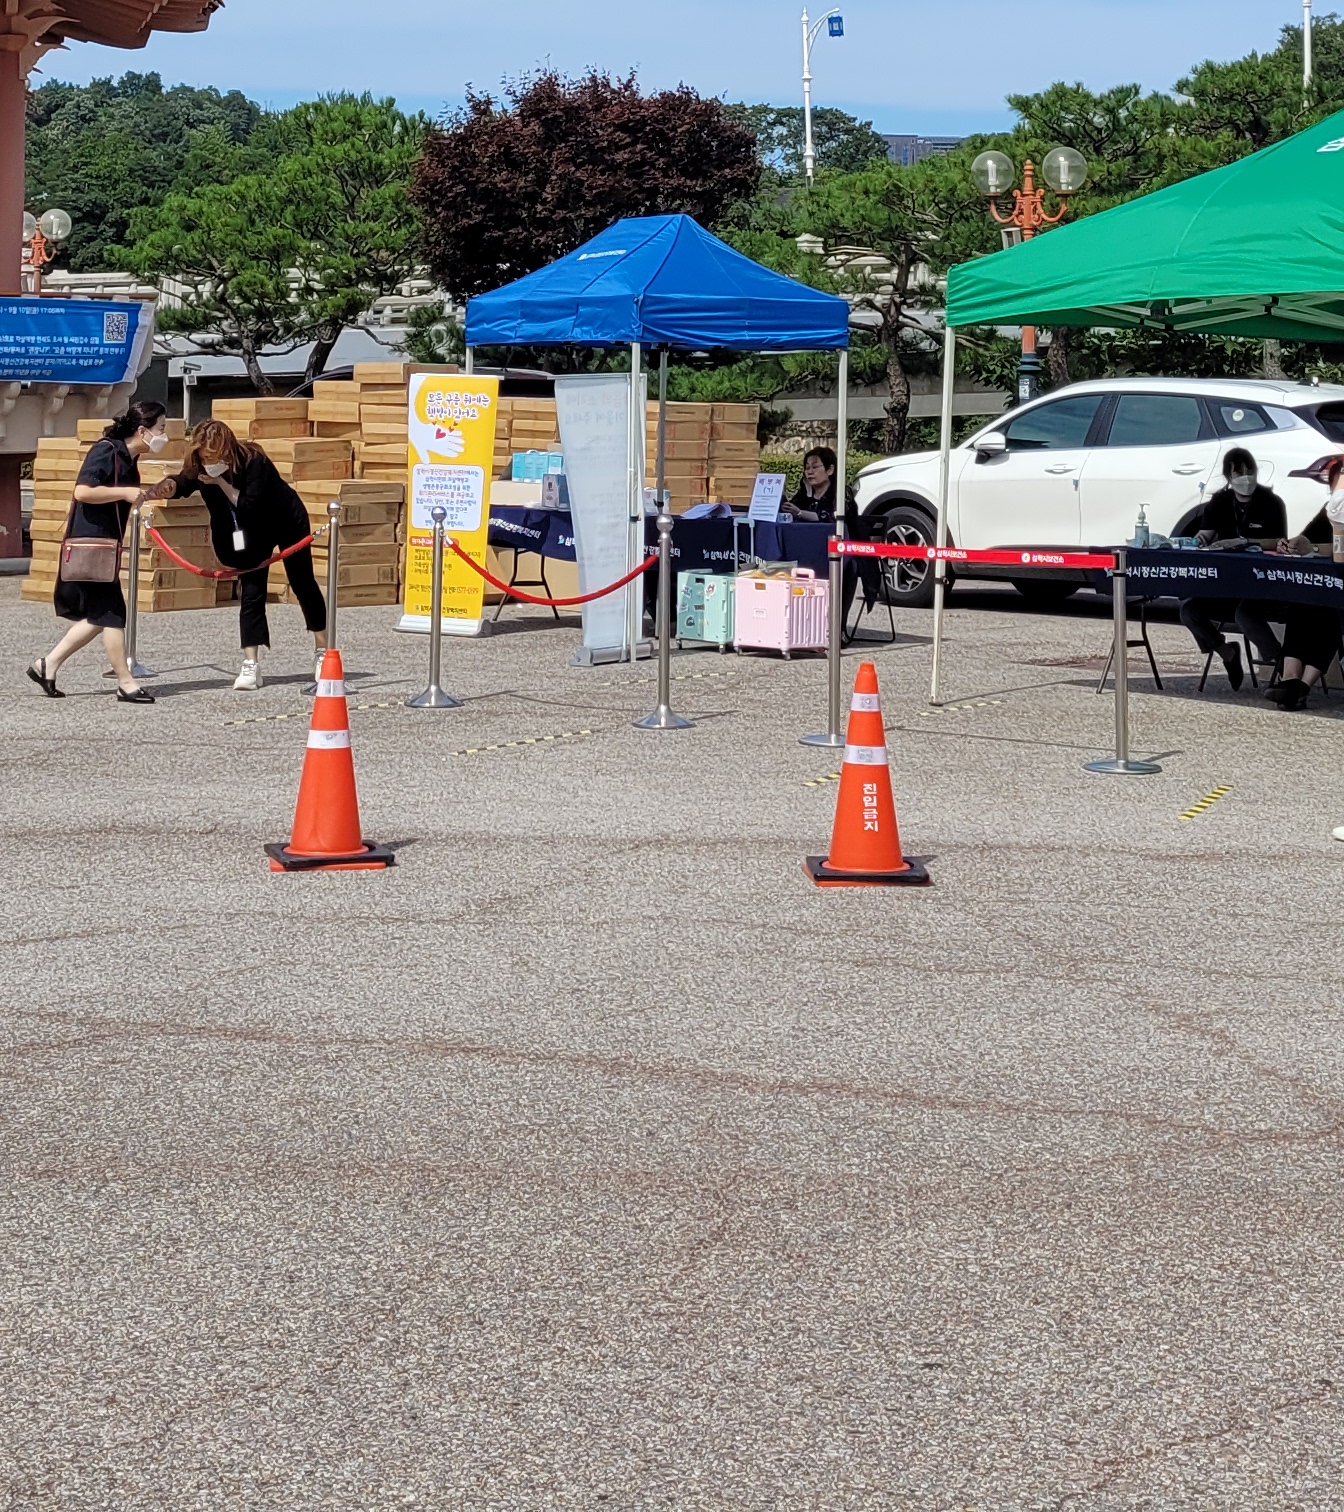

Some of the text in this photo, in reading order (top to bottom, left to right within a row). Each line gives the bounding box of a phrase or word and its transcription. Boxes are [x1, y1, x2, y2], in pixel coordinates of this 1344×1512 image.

[446, 393, 461, 405] 구름
[463, 394, 489, 407] 뒤에는
[453, 408, 478, 419] 있어요
[863, 783, 878, 832] 진입금지
